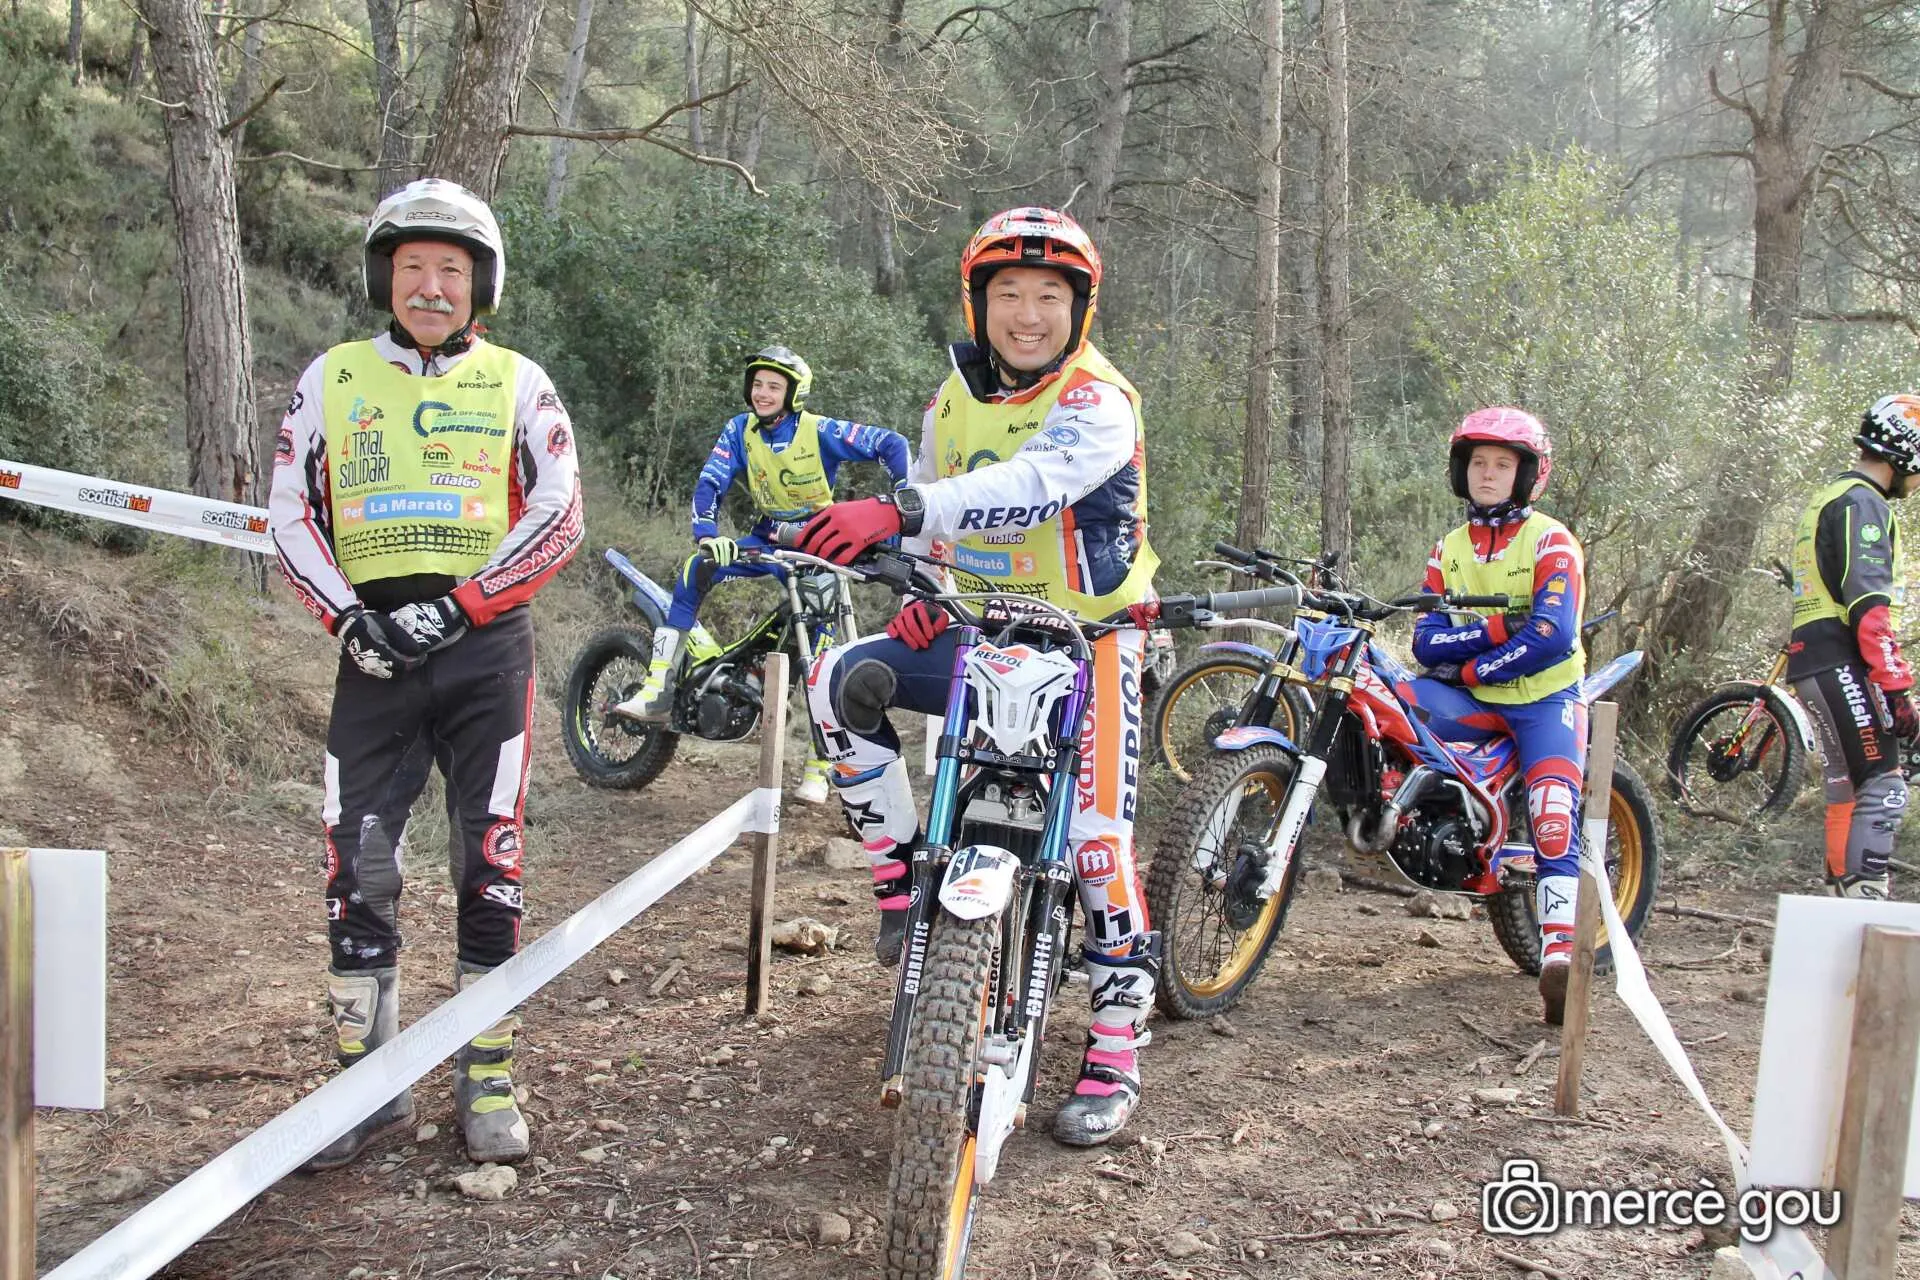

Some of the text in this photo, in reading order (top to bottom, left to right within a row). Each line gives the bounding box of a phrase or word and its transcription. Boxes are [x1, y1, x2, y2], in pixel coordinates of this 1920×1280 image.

[430, 424, 507, 438] PARCMOTOR
[423, 450, 449, 460] fcm
[370, 502, 388, 514] La
[391, 499, 454, 512] Marató
[958, 493, 1068, 530] REPSOL
[1430, 630, 1482, 645] Beta
[974, 650, 1024, 668] REPSOL
[1477, 645, 1527, 677] Beta
[1121, 650, 1142, 823] REPSOL
